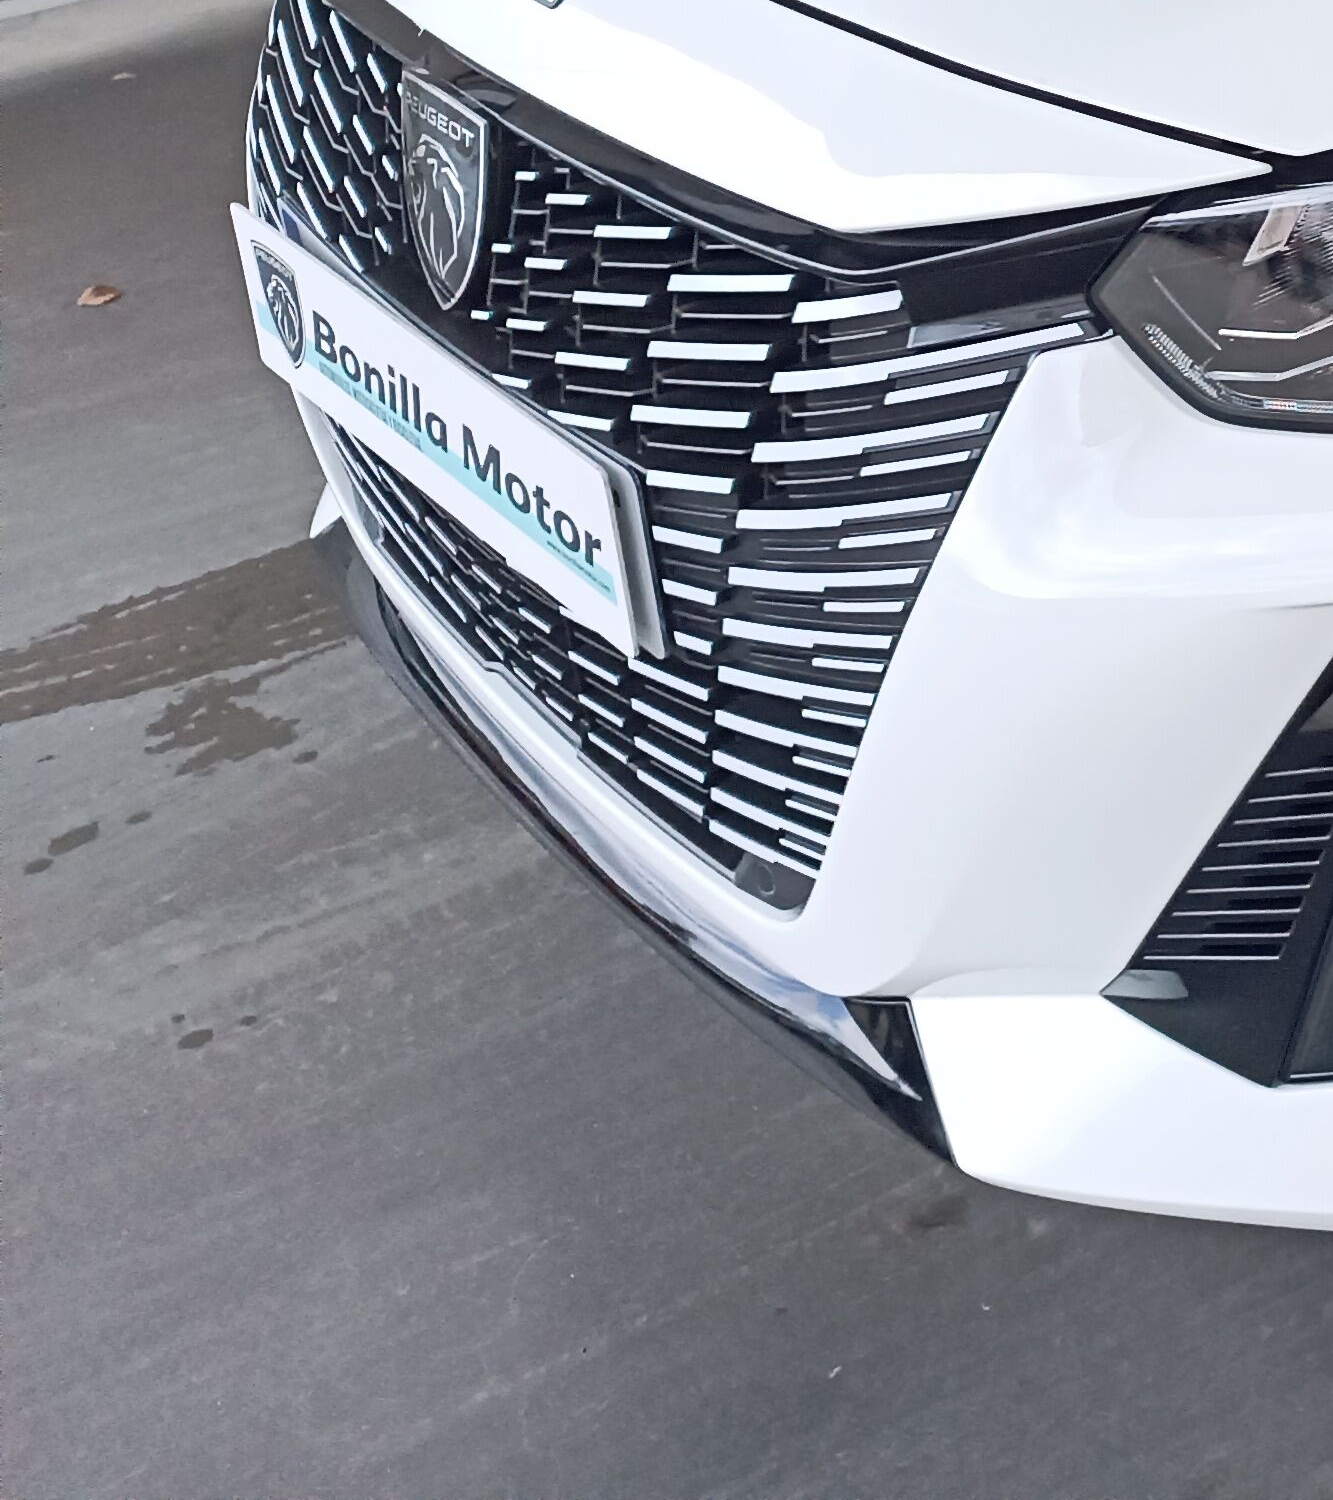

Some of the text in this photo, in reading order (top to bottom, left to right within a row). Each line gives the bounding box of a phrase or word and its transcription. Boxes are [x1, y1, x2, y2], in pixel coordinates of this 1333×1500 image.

[405, 91, 475, 148] PEUGEOT
[312, 310, 448, 454] Bonilla
[462, 423, 602, 568] Motor
